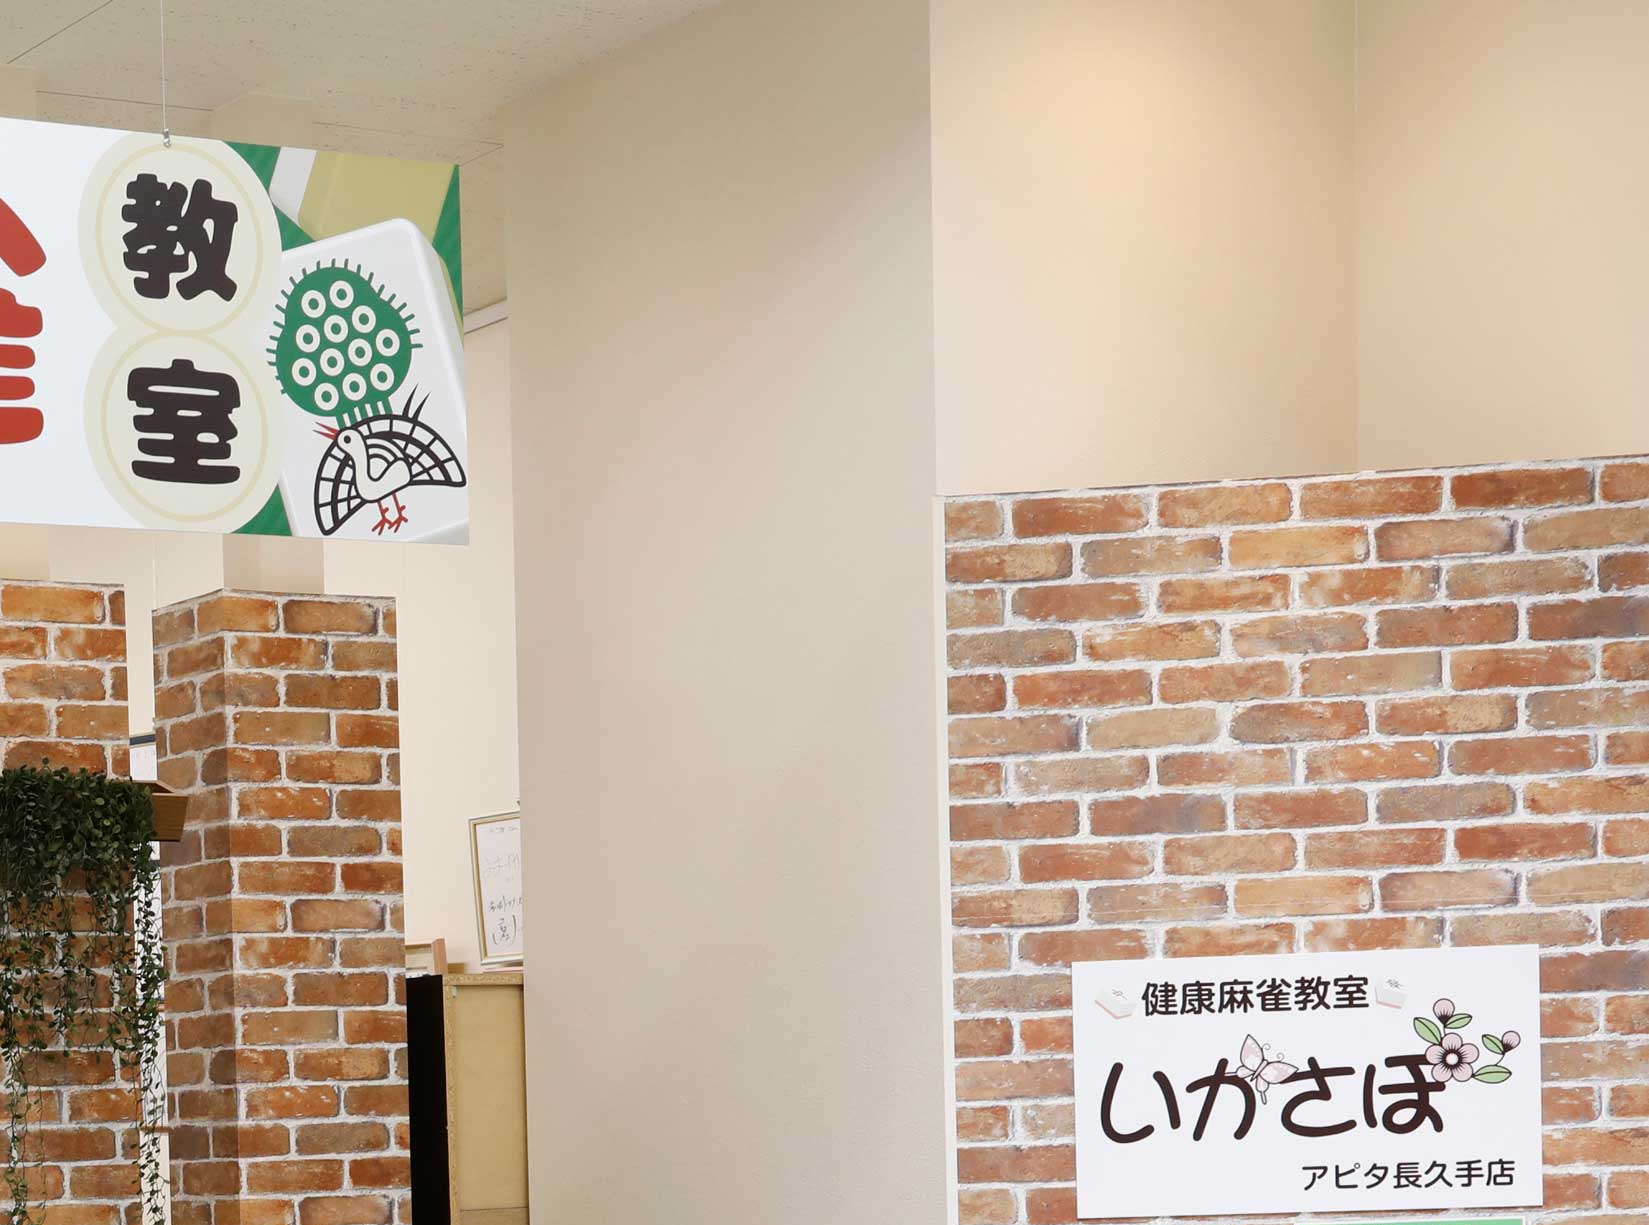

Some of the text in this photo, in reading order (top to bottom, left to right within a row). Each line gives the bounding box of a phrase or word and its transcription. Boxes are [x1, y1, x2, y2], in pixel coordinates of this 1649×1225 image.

[120, 174, 240, 485] 教室
[1141, 975, 1370, 1017] 健康麻雀教室
[1302, 1159, 1515, 1190] アピタ長久手店
